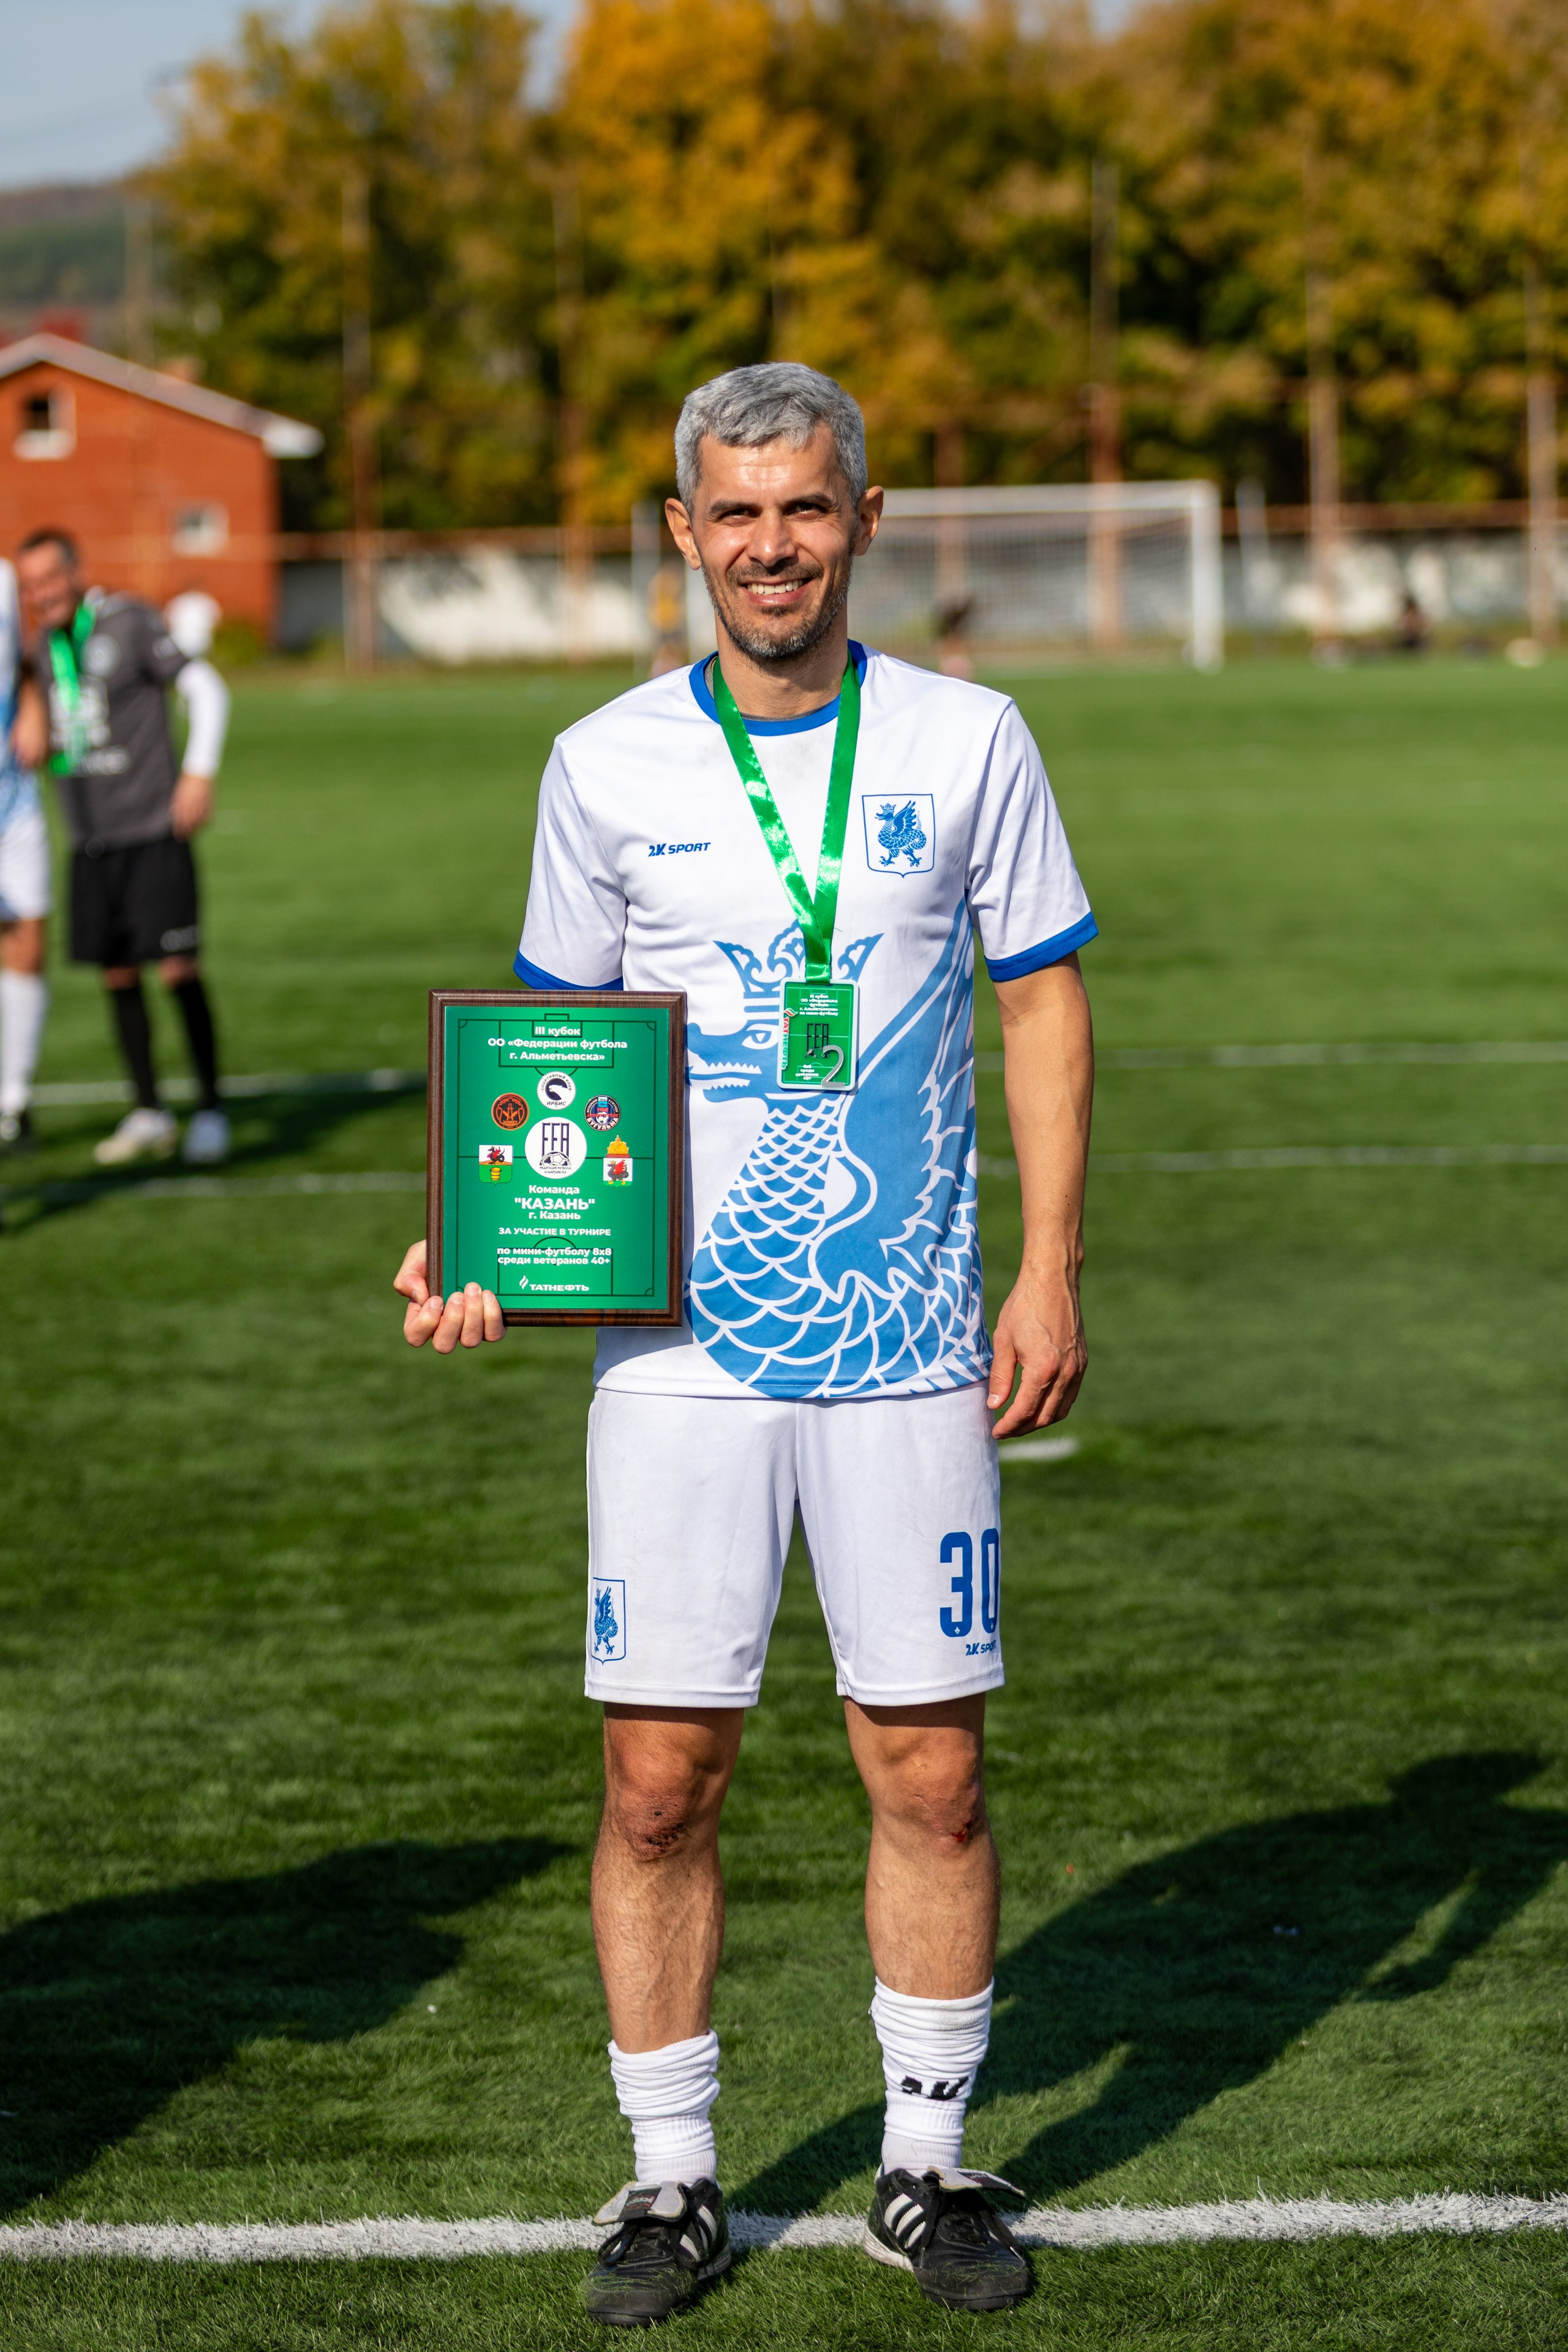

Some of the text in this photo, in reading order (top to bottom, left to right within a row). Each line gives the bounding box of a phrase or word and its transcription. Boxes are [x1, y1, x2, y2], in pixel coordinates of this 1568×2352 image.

[648, 842, 711, 857] 2K SPORT
[535, 1026, 581, 1036] III кубок
[488, 1038, 627, 1049] ОО «Федерации футбола
[520, 1052, 605, 1061] Альметьевска»
[821, 1045, 845, 1087] 2
[541, 1074, 566, 1090] СПОРТИВНЫЙ
[587, 1117, 619, 1130] БУГУЛЬМА
[529, 1185, 579, 1194] Команда
[514, 1197, 595, 1210] "КАЗАНЬ"
[540, 1211, 581, 1219] Казань
[513, 1247, 590, 1257] мини-футболу
[533, 1257, 588, 1266] ветеранов
[940, 1528, 999, 1637] 30
[981, 1640, 997, 1654] SPORT
